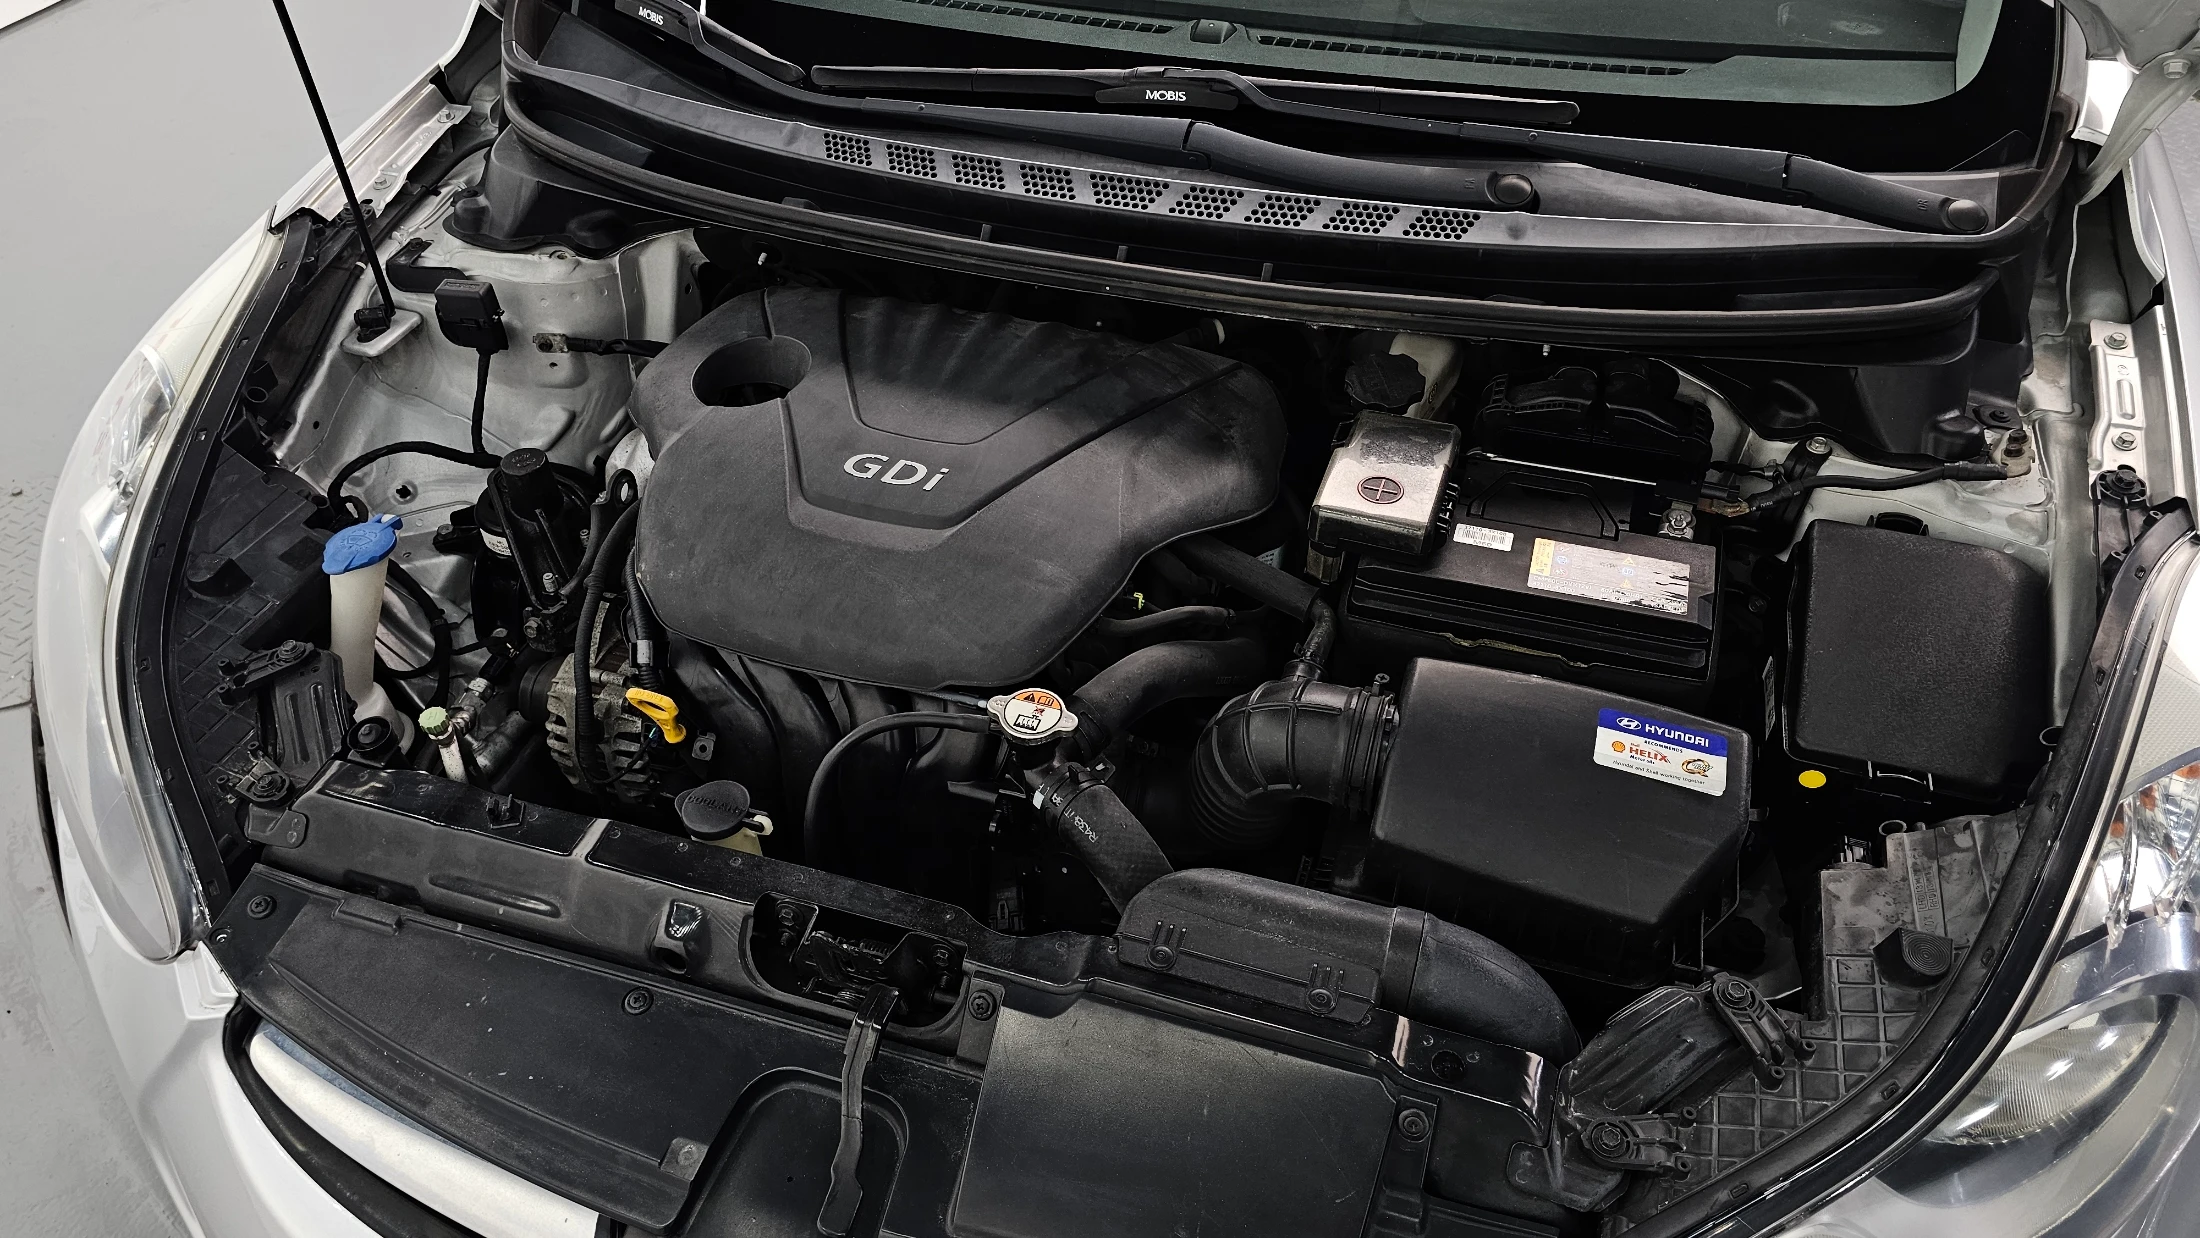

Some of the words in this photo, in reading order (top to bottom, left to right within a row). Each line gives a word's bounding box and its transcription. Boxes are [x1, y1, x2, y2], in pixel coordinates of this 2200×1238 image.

[638, 6, 664, 26] MOBIS
[1145, 89, 1187, 102] MOBIS
[843, 453, 950, 491] GDi
[1645, 724, 1710, 748] HYUNDAI
[1644, 740, 1683, 753] RECOMMENDS
[1629, 747, 1669, 763] HELIX
[1660, 772, 1681, 781] working
[1682, 776, 1705, 785] together
